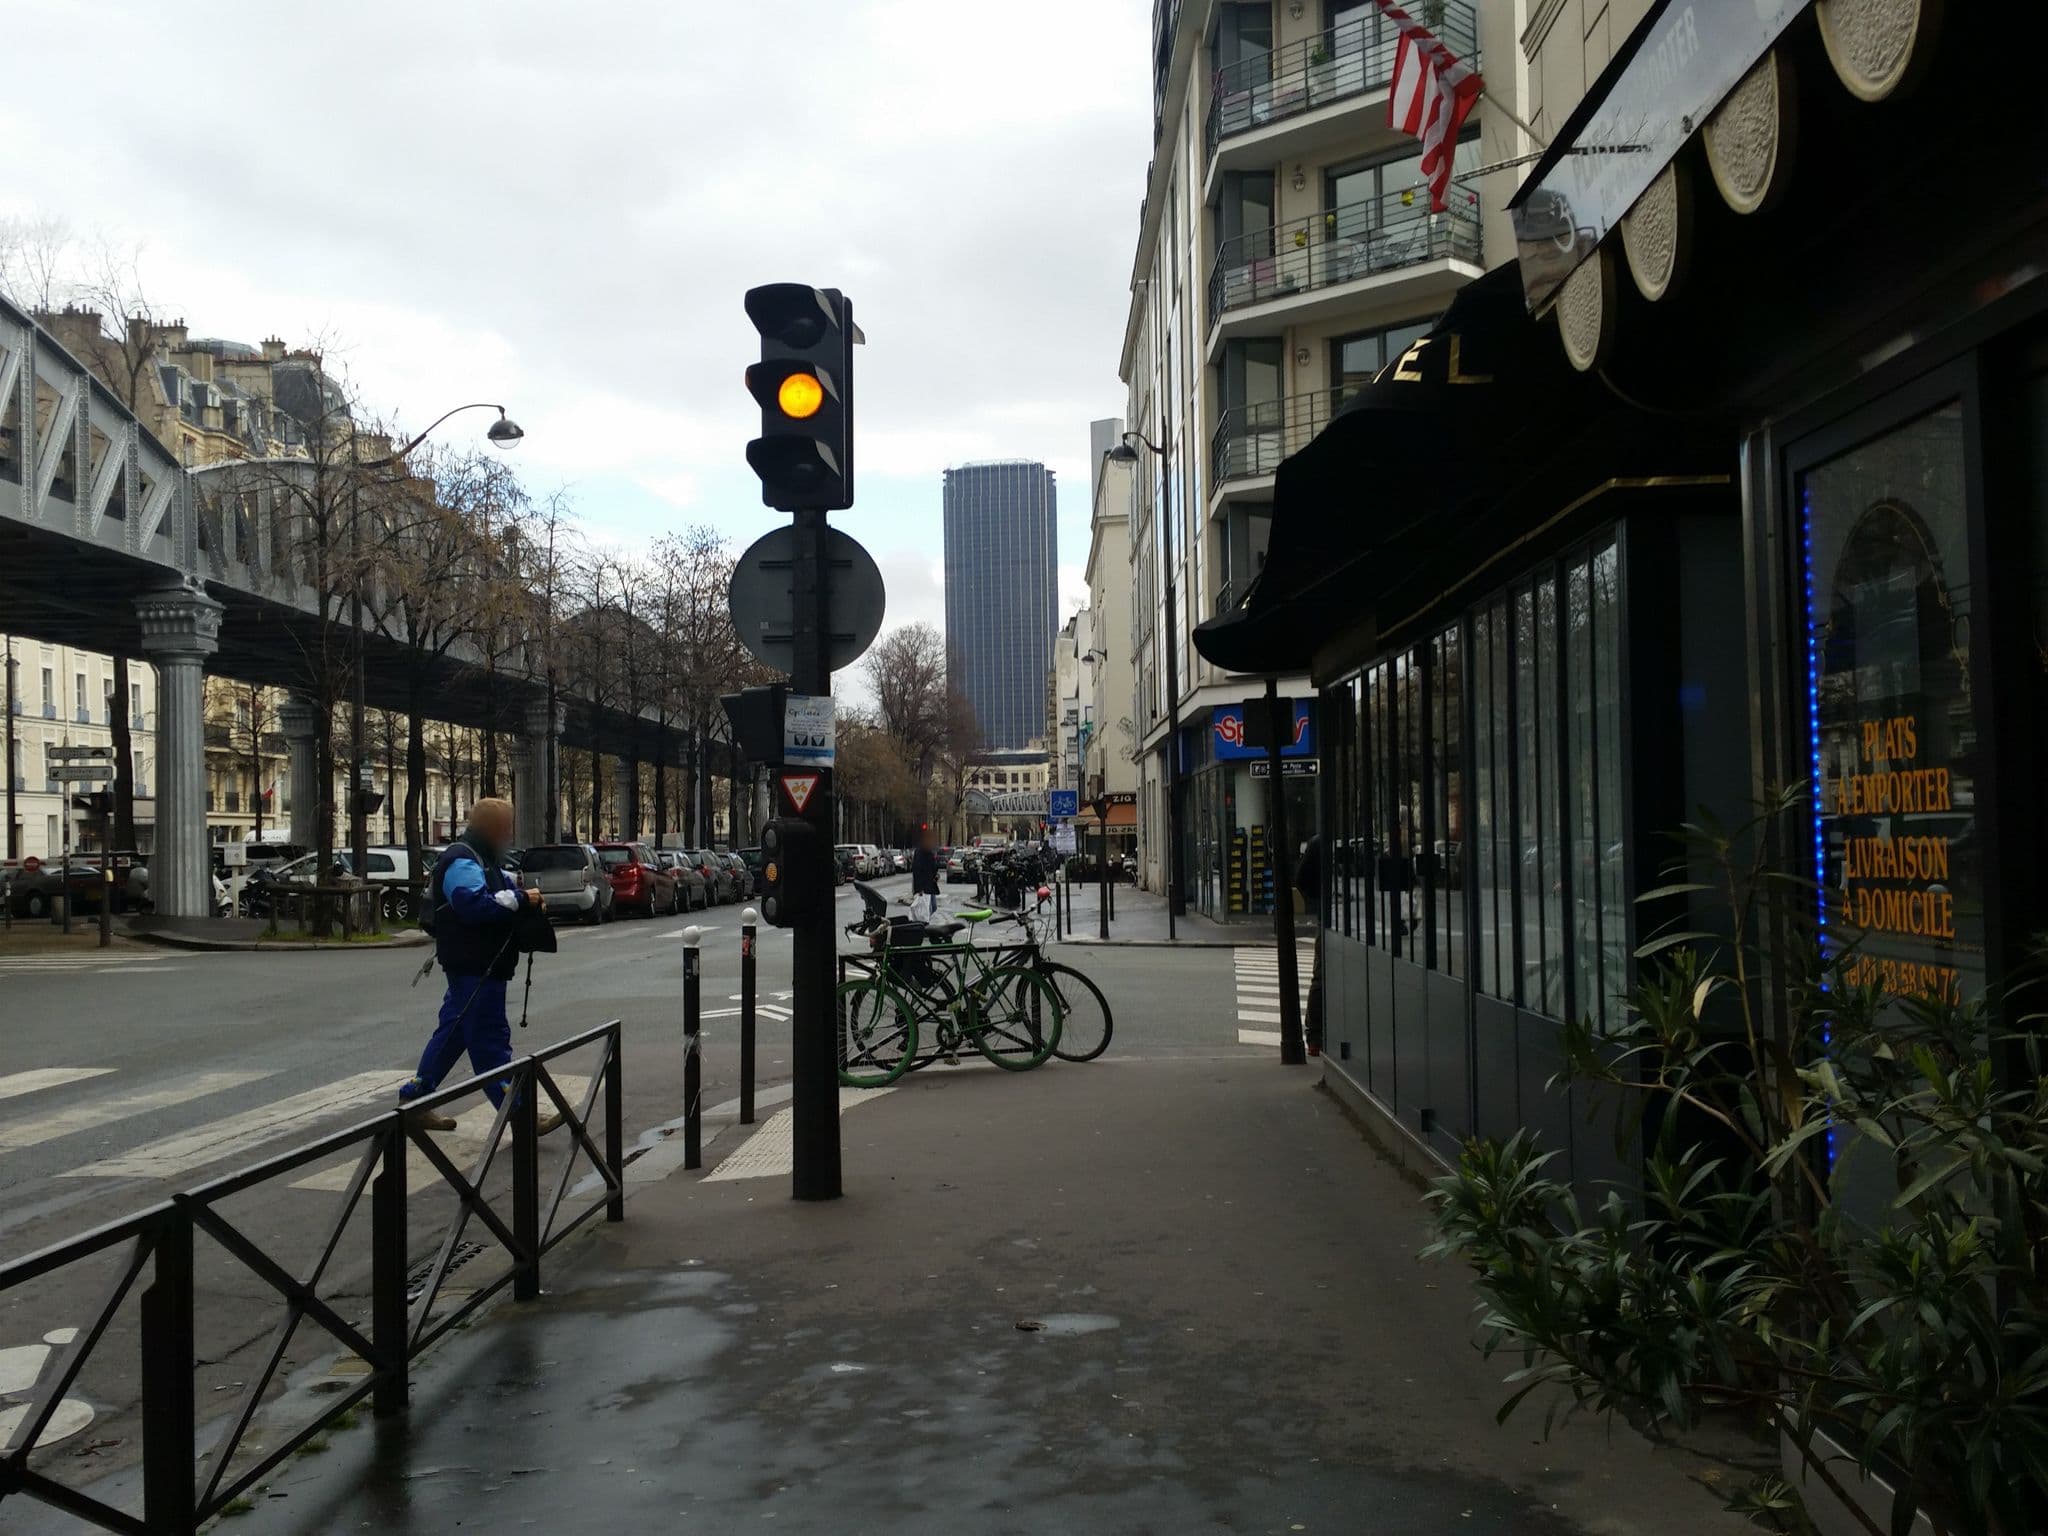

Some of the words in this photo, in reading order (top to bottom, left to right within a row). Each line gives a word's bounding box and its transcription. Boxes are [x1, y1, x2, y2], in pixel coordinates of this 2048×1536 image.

[1863, 716, 1917, 762] PLATS
[1837, 776, 1849, 816] A
[1851, 767, 1951, 815] EMPORTER
[1844, 835, 1949, 881] LIVRAISON
[1857, 887, 1956, 939] DOMICILE
